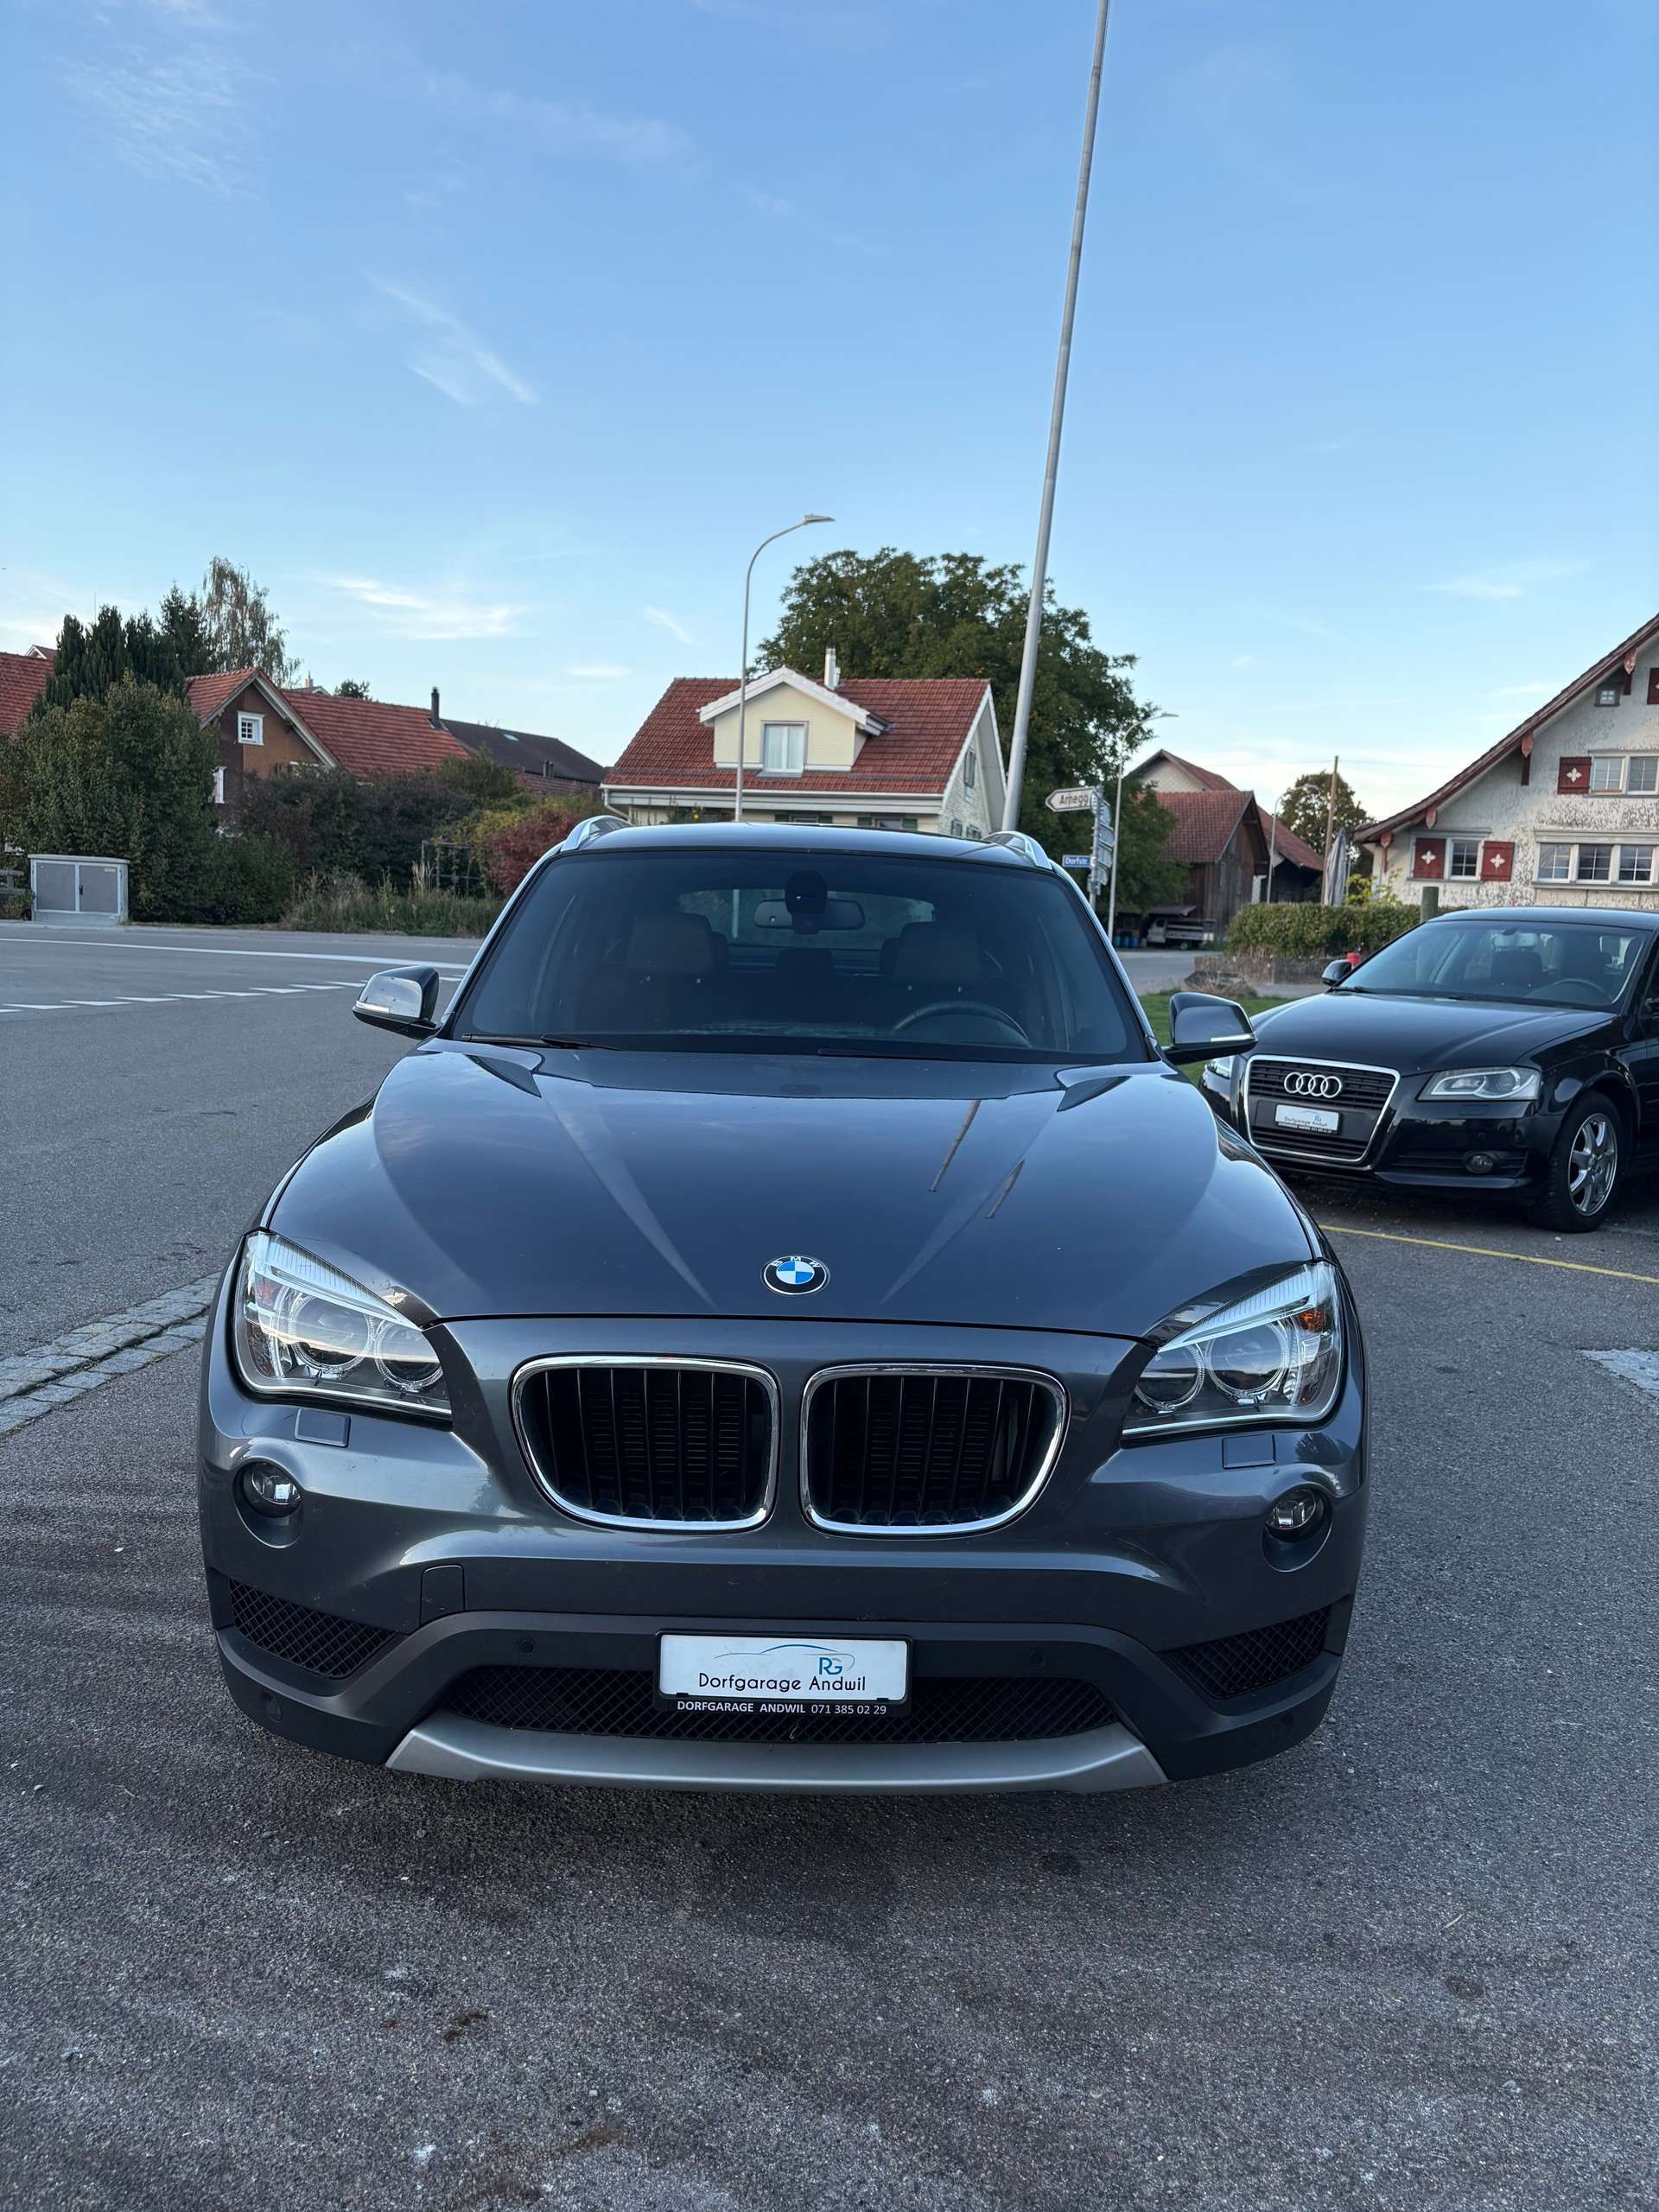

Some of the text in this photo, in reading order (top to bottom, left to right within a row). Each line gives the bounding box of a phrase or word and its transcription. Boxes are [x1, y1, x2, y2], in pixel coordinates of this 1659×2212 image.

[1059, 794, 1089, 807] Arnegg
[1065, 857, 1090, 866] Dorfstr.
[770, 1255, 822, 1268] BMW
[818, 1656, 843, 1675] RG
[698, 1673, 866, 1692] Dorfgarage Andwil
[677, 1700, 887, 1715] DORFGARAGE ANDWIL 071 385 02 29
